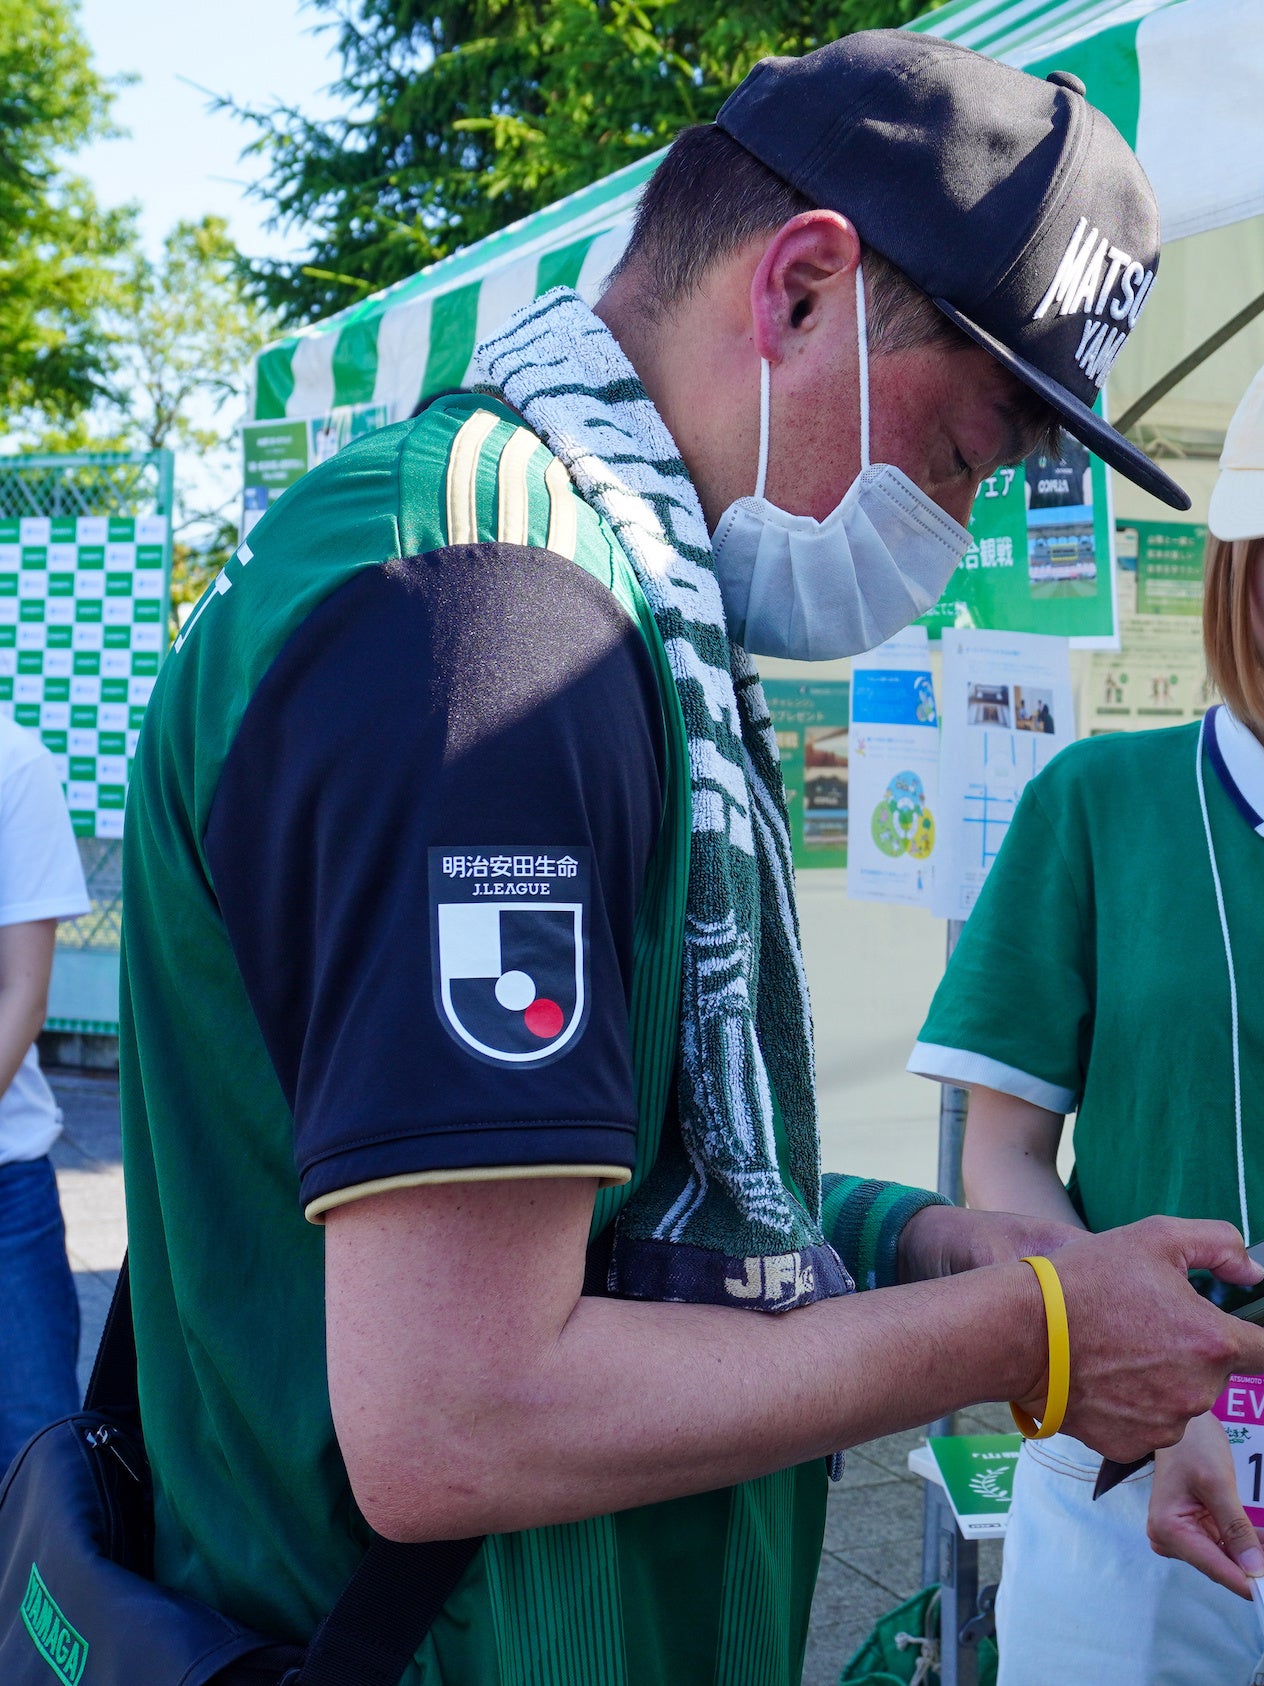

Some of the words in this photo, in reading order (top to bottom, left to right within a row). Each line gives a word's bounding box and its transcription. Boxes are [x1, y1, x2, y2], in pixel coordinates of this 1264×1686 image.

[975, 469, 1015, 498] ェア
[958, 536, 1014, 569] 合観戦
[442, 855, 578, 878] 明治安田生命
[472, 883, 550, 896] J.LEAGUE
[1229, 1376, 1262, 1385] ATSUMOTO
